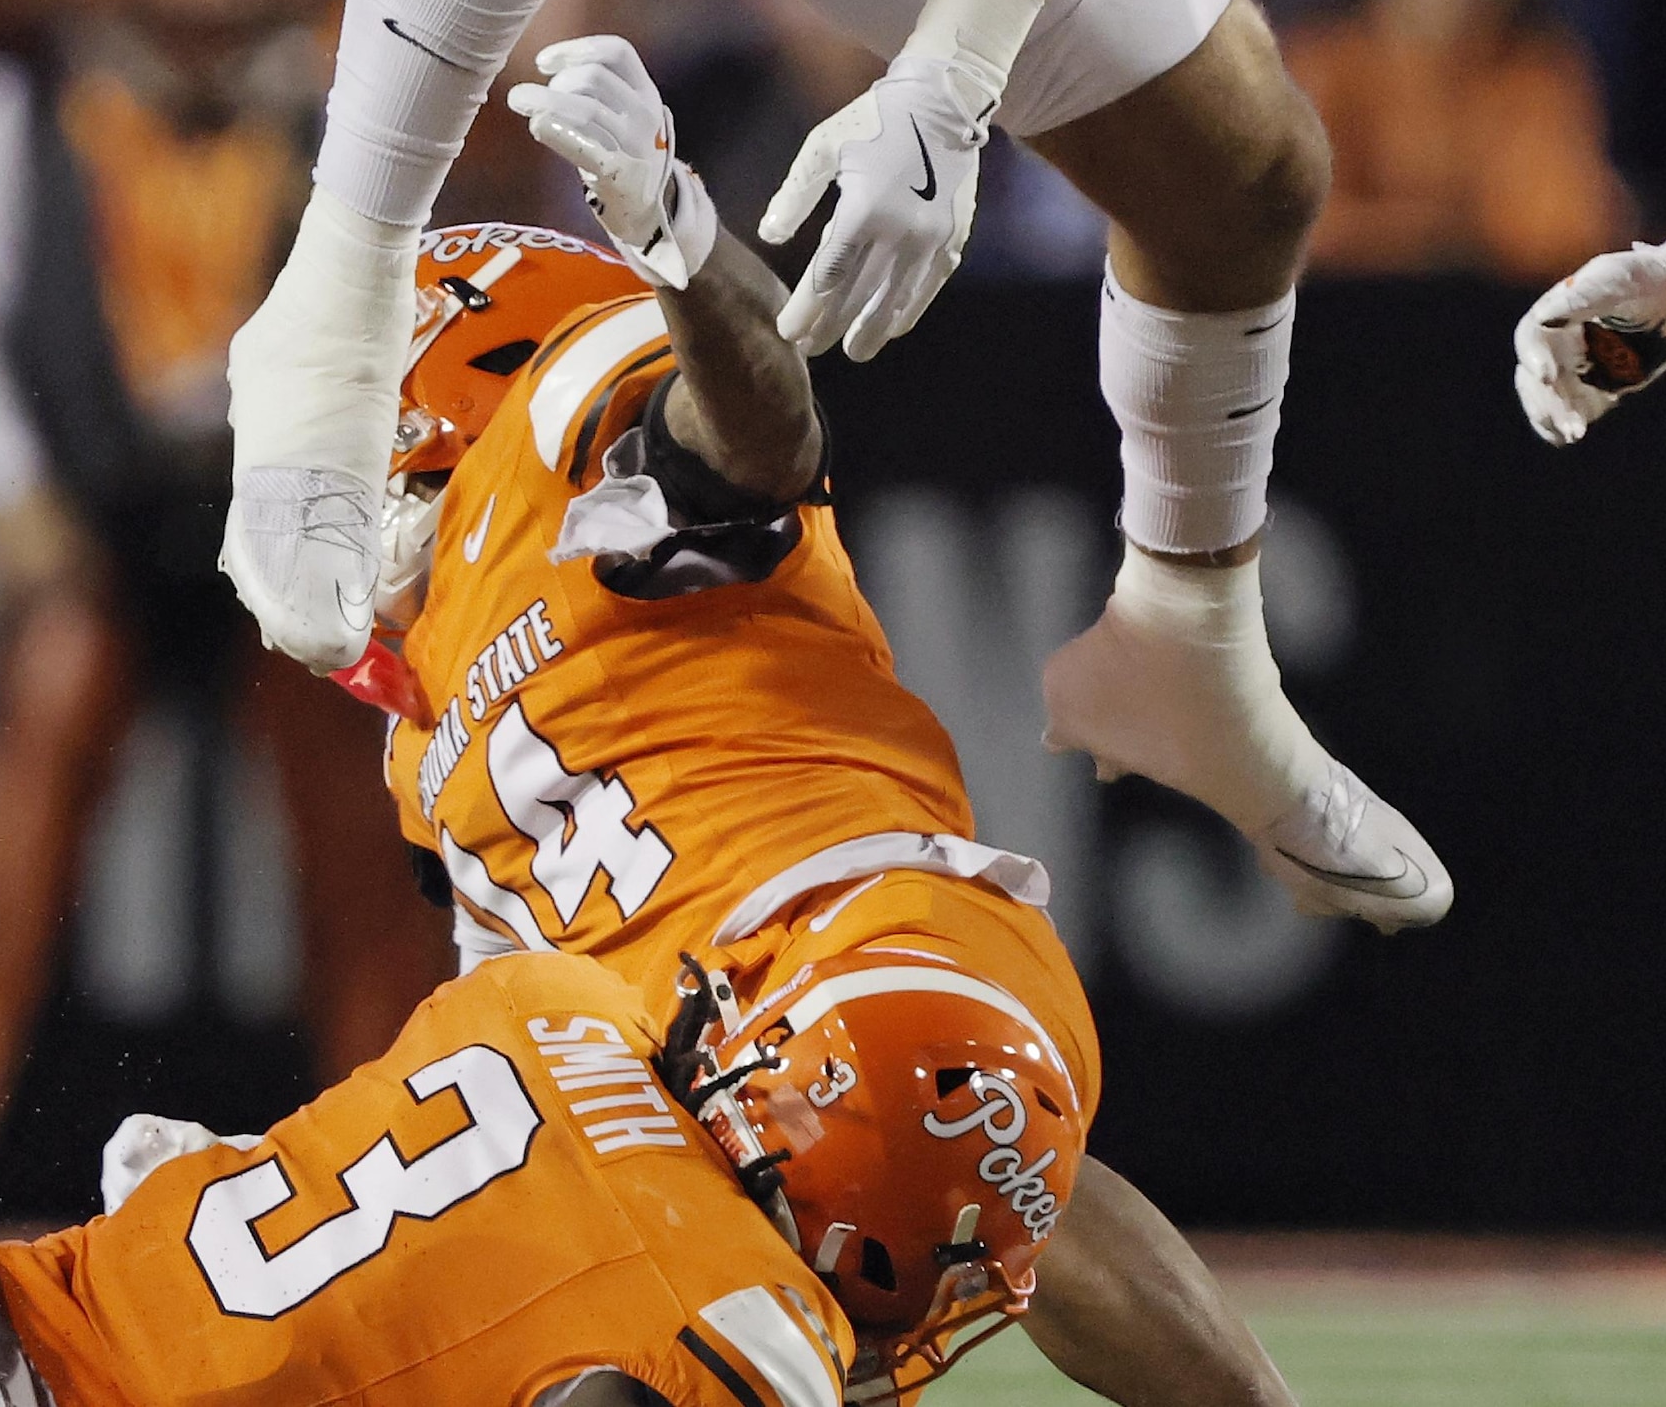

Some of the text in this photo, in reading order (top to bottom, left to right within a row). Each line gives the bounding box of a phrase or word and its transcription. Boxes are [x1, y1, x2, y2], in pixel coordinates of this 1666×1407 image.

[466, 597, 565, 722] STATE
[526, 1015, 687, 1155] SMITH
[807, 1060, 858, 1109] 3
[186, 1044, 544, 1319] 3
